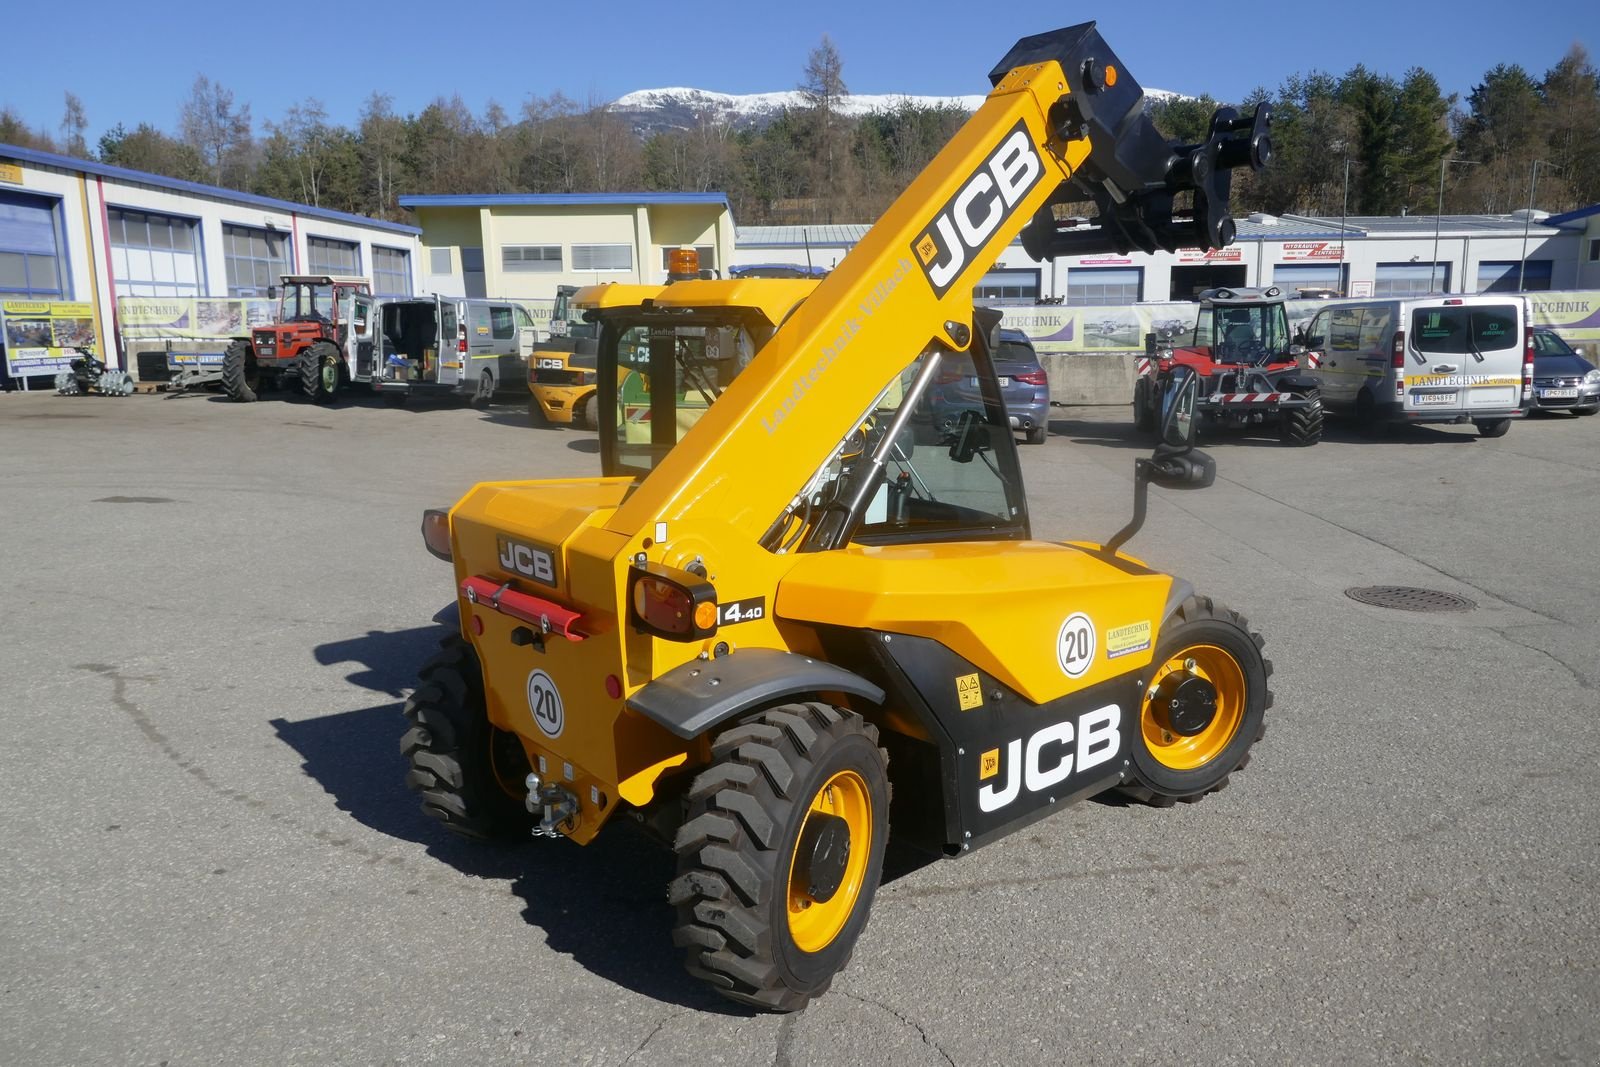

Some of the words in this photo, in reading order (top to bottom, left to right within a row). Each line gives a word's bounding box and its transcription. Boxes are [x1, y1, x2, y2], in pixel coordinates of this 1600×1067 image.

[928, 130, 1040, 288] JCB
[1001, 315, 1062, 327] DTECHNIK
[1532, 301, 1590, 314] TECHNIK
[535, 358, 564, 369] JCB
[760, 256, 913, 437] Landtechnik-Villach
[500, 541, 553, 583] JCB
[1064, 627, 1089, 664] 20
[1108, 622, 1149, 641] LANDTECHNIK
[534, 684, 557, 724] 20
[978, 703, 1121, 813] JCB
[985, 758, 996, 772] JCB
